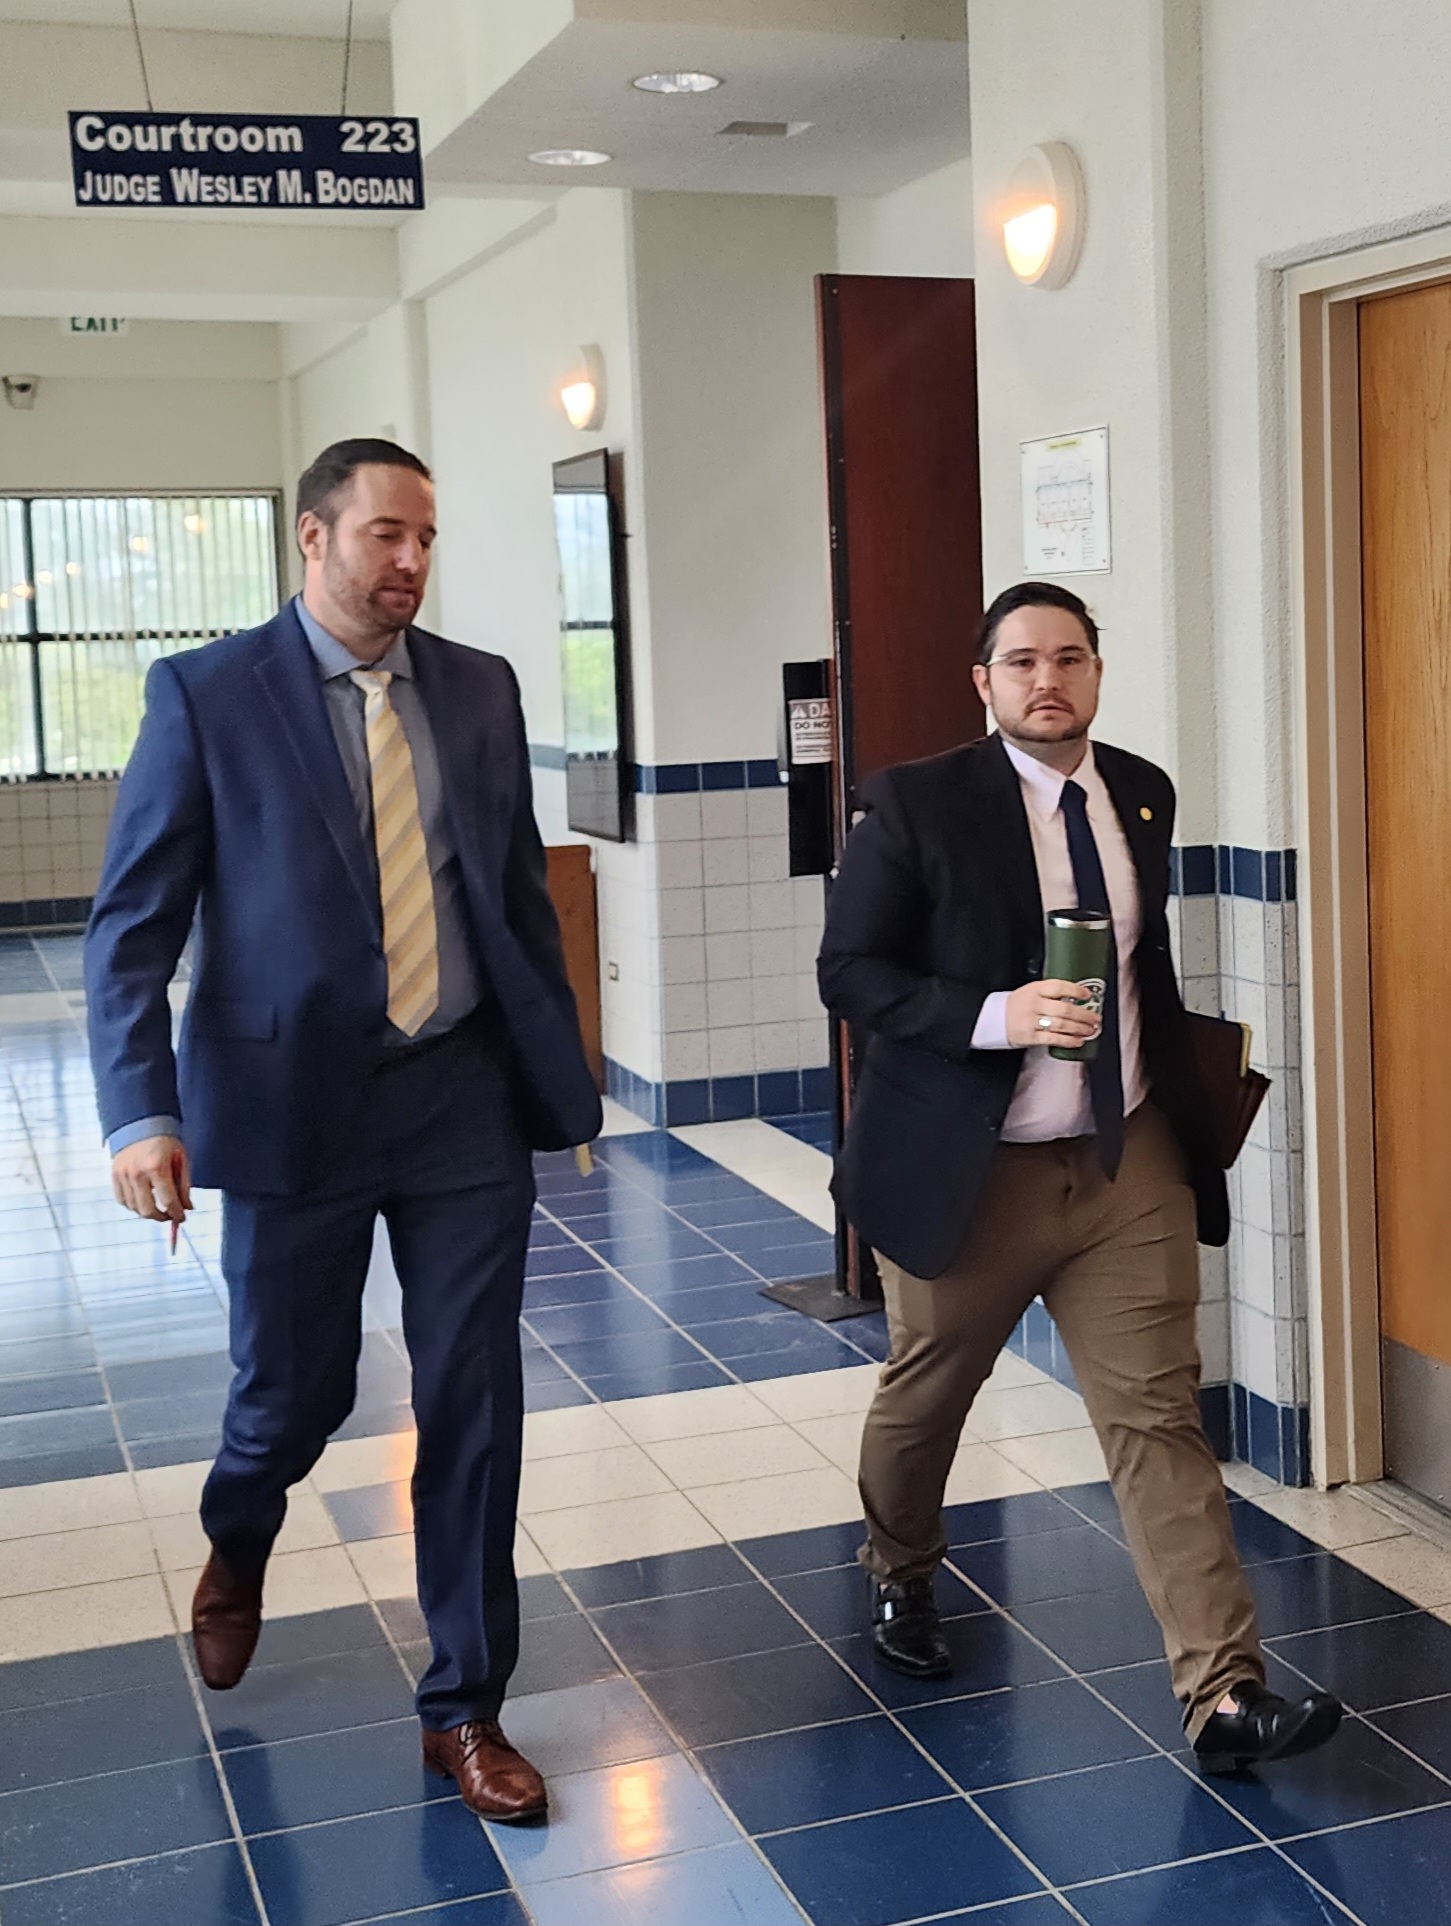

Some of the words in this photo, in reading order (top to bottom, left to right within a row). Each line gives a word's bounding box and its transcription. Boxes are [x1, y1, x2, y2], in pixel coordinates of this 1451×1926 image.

[75, 115, 304, 153] Courtroom
[339, 121, 416, 153] 223
[78, 169, 162, 202] JUDGE
[169, 167, 273, 204] WESLEY
[276, 169, 312, 205] M.
[315, 169, 415, 205] BOGDAN
[794, 722, 810, 730] DO
[813, 721, 831, 729] NO
